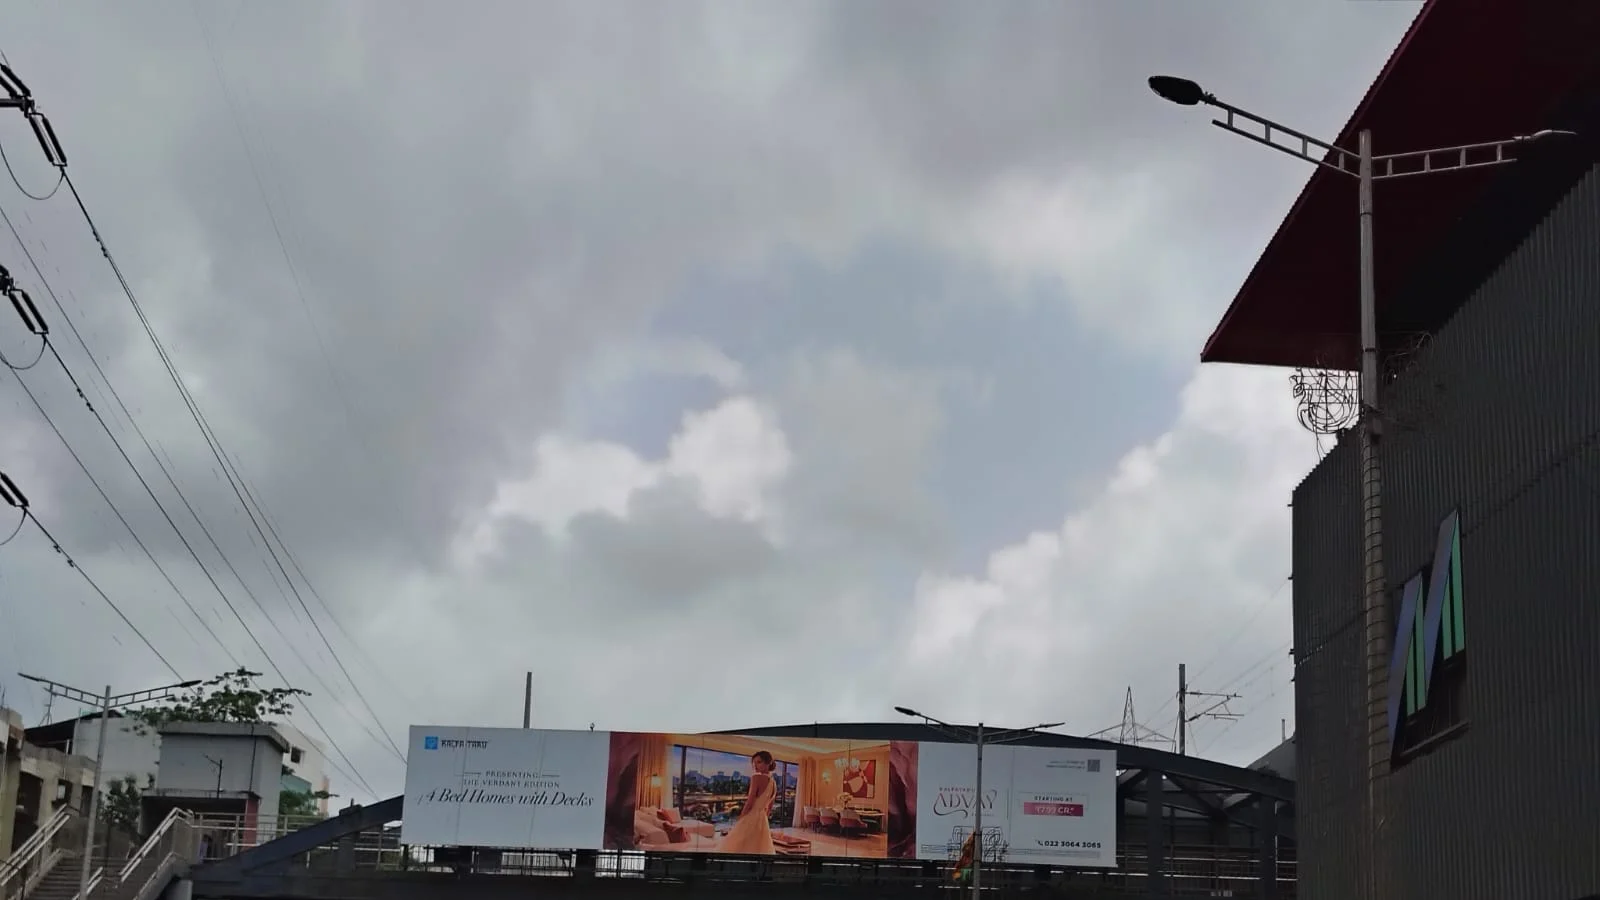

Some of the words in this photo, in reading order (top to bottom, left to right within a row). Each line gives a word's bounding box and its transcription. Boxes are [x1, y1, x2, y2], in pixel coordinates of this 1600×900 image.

[485, 771, 539, 779] PRESENTING
[482, 779, 521, 788] VERDANT
[524, 780, 560, 789] EDITION
[438, 788, 469, 803] Bed
[469, 789, 516, 805] Homes
[518, 790, 548, 806] with
[550, 791, 594, 807] Decks
[1060, 840, 1080, 848] 3064
[1081, 841, 1102, 849] 3065
